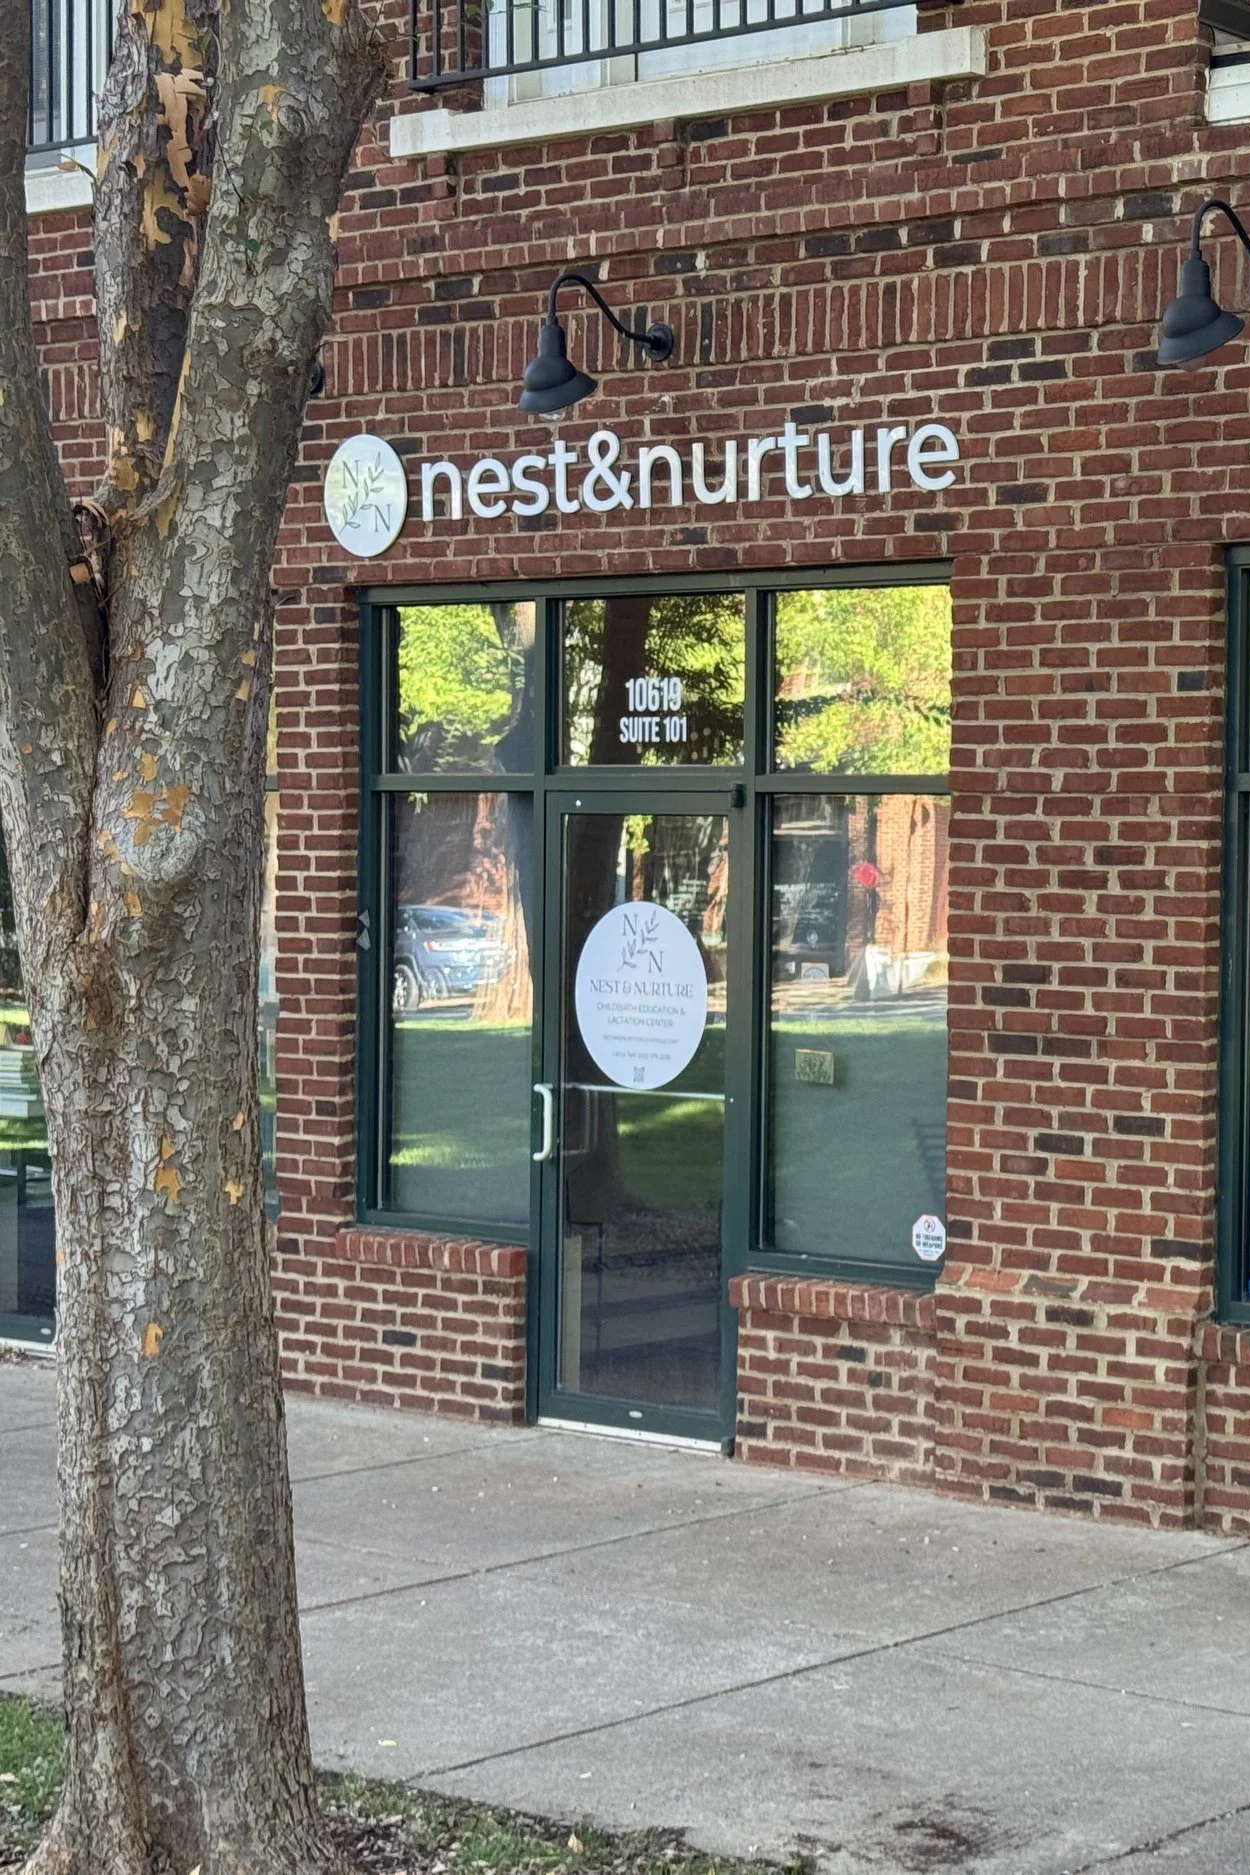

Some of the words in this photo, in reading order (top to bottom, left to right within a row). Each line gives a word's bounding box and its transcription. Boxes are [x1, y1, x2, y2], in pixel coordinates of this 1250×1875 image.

[342, 460, 360, 489] N
[421, 421, 961, 522] nest&nurture
[374, 504, 392, 533] N
[625, 677, 682, 712] 10619
[619, 716, 660, 743] SUITE
[663, 716, 687, 743] 101
[622, 913, 638, 936] N
[648, 950, 664, 973] N
[590, 979, 620, 995] NEST
[622, 980, 632, 995] &
[633, 981, 694, 999] NURTURE
[596, 1002, 637, 1013] CHILDBIRTH
[638, 1004, 679, 1015] EDUCATION
[680, 1007, 686, 1016] &
[607, 1016, 645, 1026] LACTATION
[646, 1018, 673, 1028] CENTER
